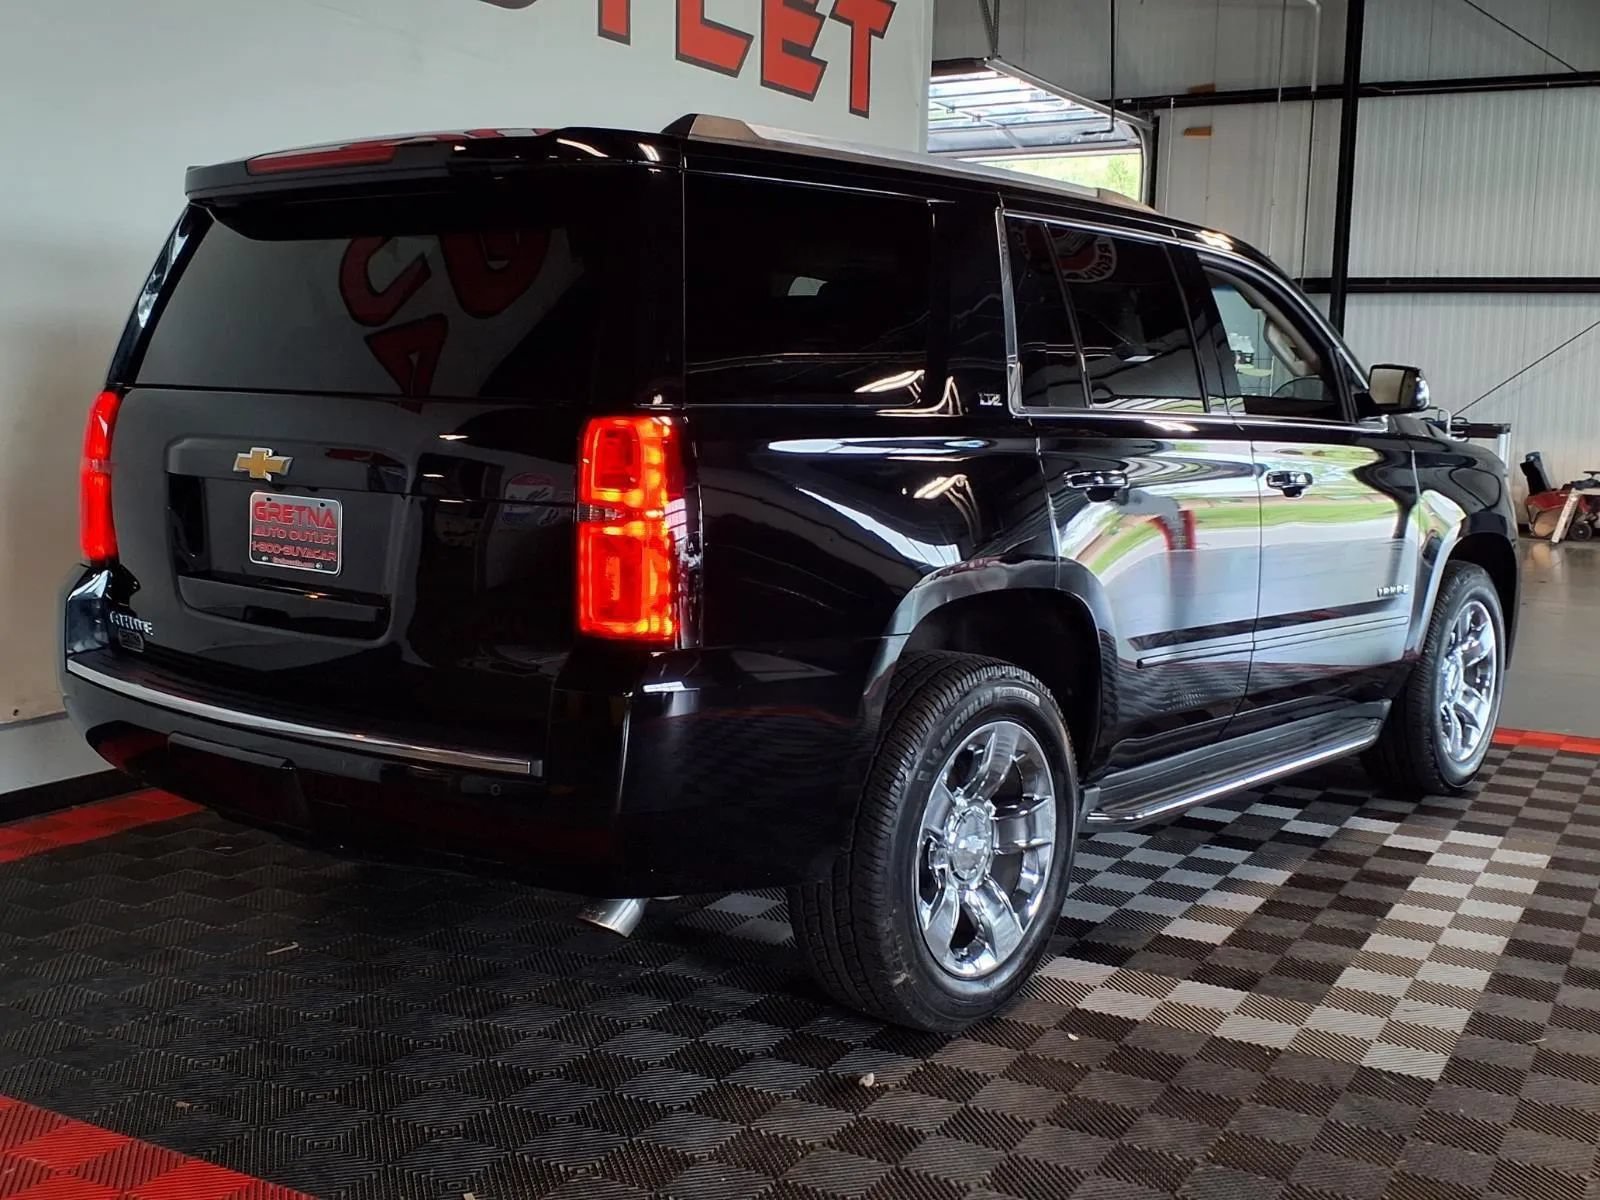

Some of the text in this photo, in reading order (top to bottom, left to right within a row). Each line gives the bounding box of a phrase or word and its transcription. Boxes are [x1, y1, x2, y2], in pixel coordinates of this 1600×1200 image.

[254, 501, 337, 530] GRETNA
[252, 525, 337, 545] AUTO OUTLET
